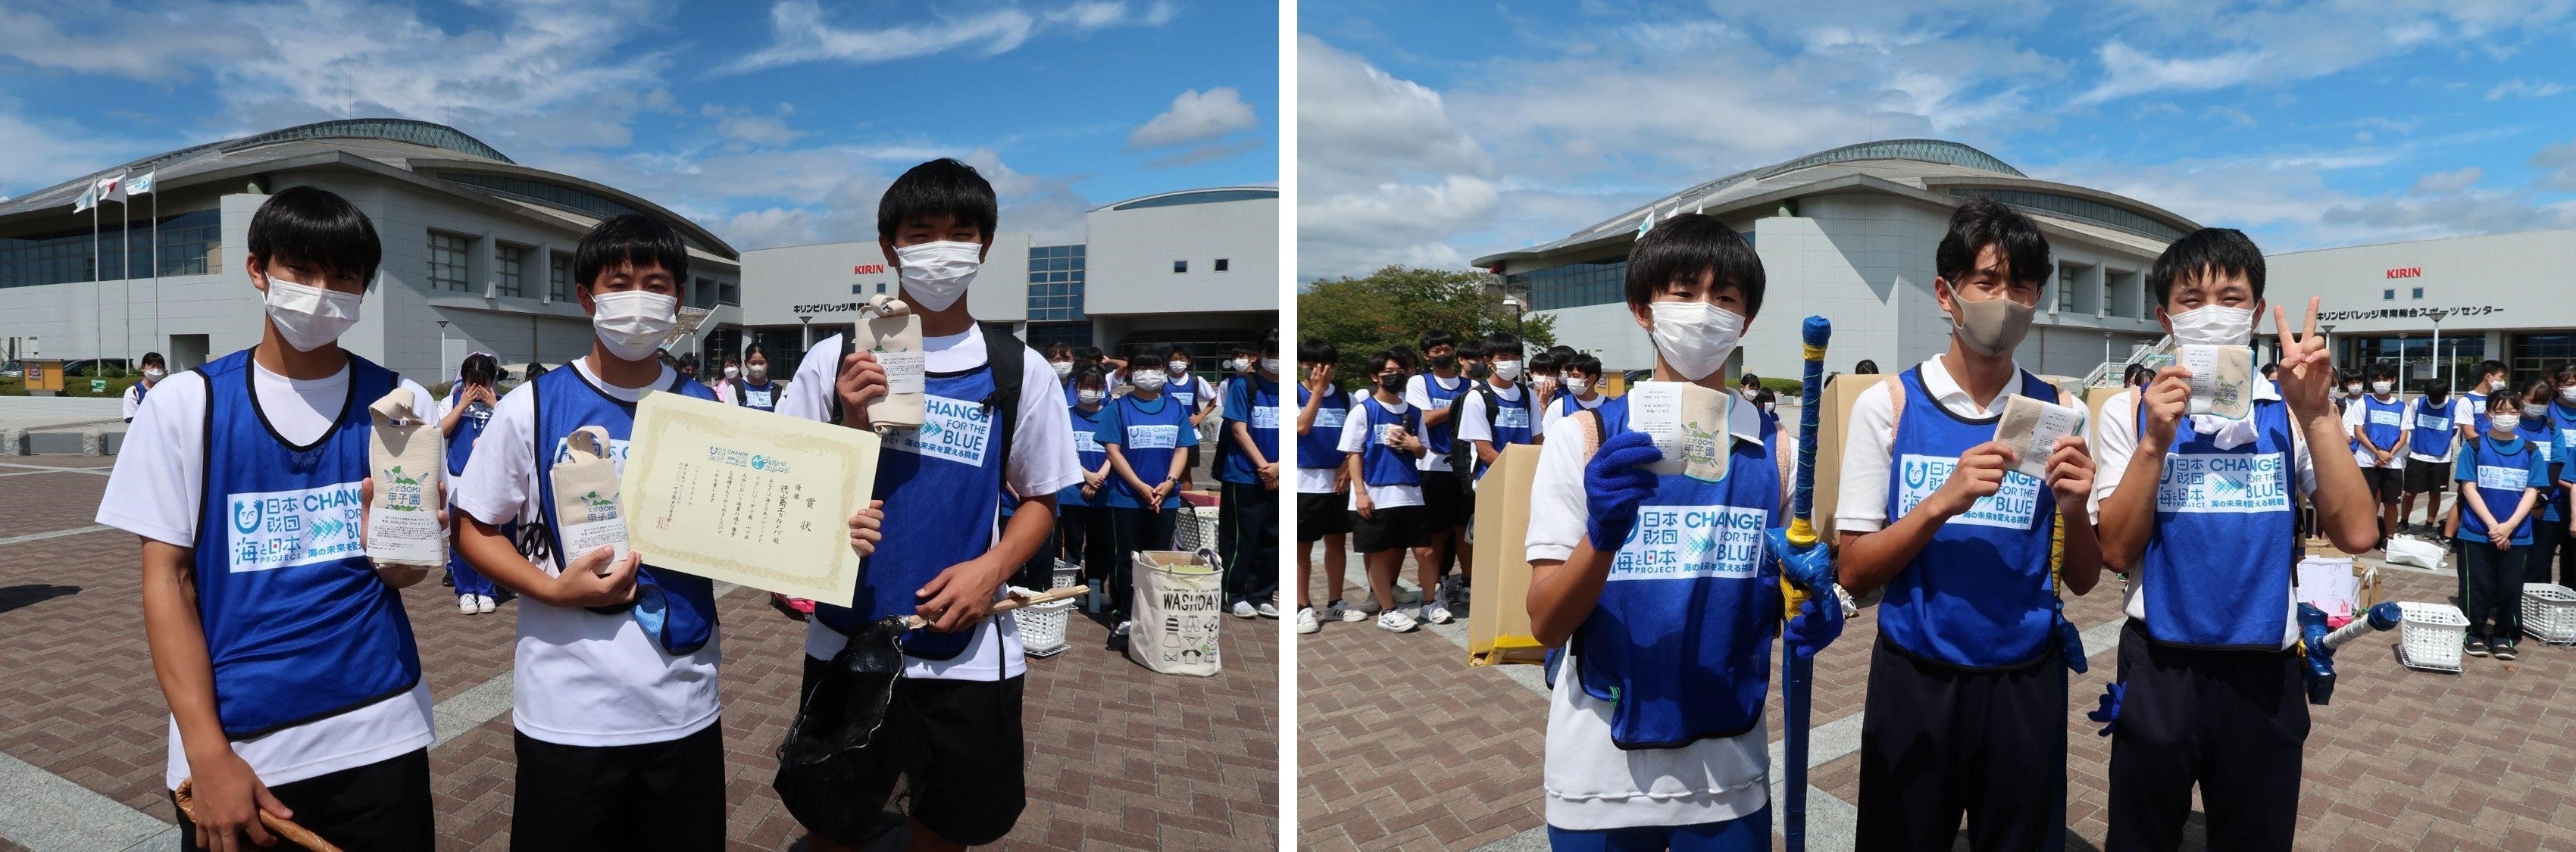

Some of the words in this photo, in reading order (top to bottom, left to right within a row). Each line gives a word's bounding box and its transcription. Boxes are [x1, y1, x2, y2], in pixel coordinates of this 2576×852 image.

[855, 264, 884, 275] KIRIN
[2387, 267, 2421, 279] KIRIN
[2215, 392, 2238, 401] 甲子園
[925, 399, 988, 423] HANGE
[946, 419, 968, 430] FOR
[969, 423, 987, 435] THE
[943, 429, 984, 451] BLUE
[1686, 438, 1715, 447] スポGOMI
[904, 438, 980, 461] 海の未来を変える挑戦
[1684, 445, 1715, 457] 甲子園
[2177, 458, 2204, 471] 日本
[2209, 457, 2281, 473] CHANGE
[1930, 477, 1943, 491] 財
[2246, 473, 2262, 482] FOR
[2265, 472, 2283, 481] THE
[1998, 486, 2018, 495] FOR
[2019, 488, 2035, 498] THE
[2246, 482, 2284, 498] BLUE
[267, 497, 299, 514] 日本
[388, 492, 420, 505] 甲子園
[1996, 497, 2033, 515] BLUE
[2211, 498, 2285, 508] 海の未来を変える挑戦
[267, 515, 301, 533] 財団
[588, 512, 617, 523] 甲子園
[1643, 511, 1678, 526] 日本
[1684, 511, 1763, 531] CHANGE
[1643, 529, 1678, 545] 財団
[1720, 531, 1739, 541] FOR
[1743, 533, 1760, 543] THE
[236, 536, 302, 566] 海と日本
[260, 553, 302, 563] PROJECT
[1716, 544, 1758, 562] BLUE
[1164, 593, 1221, 611] WASHDAY
